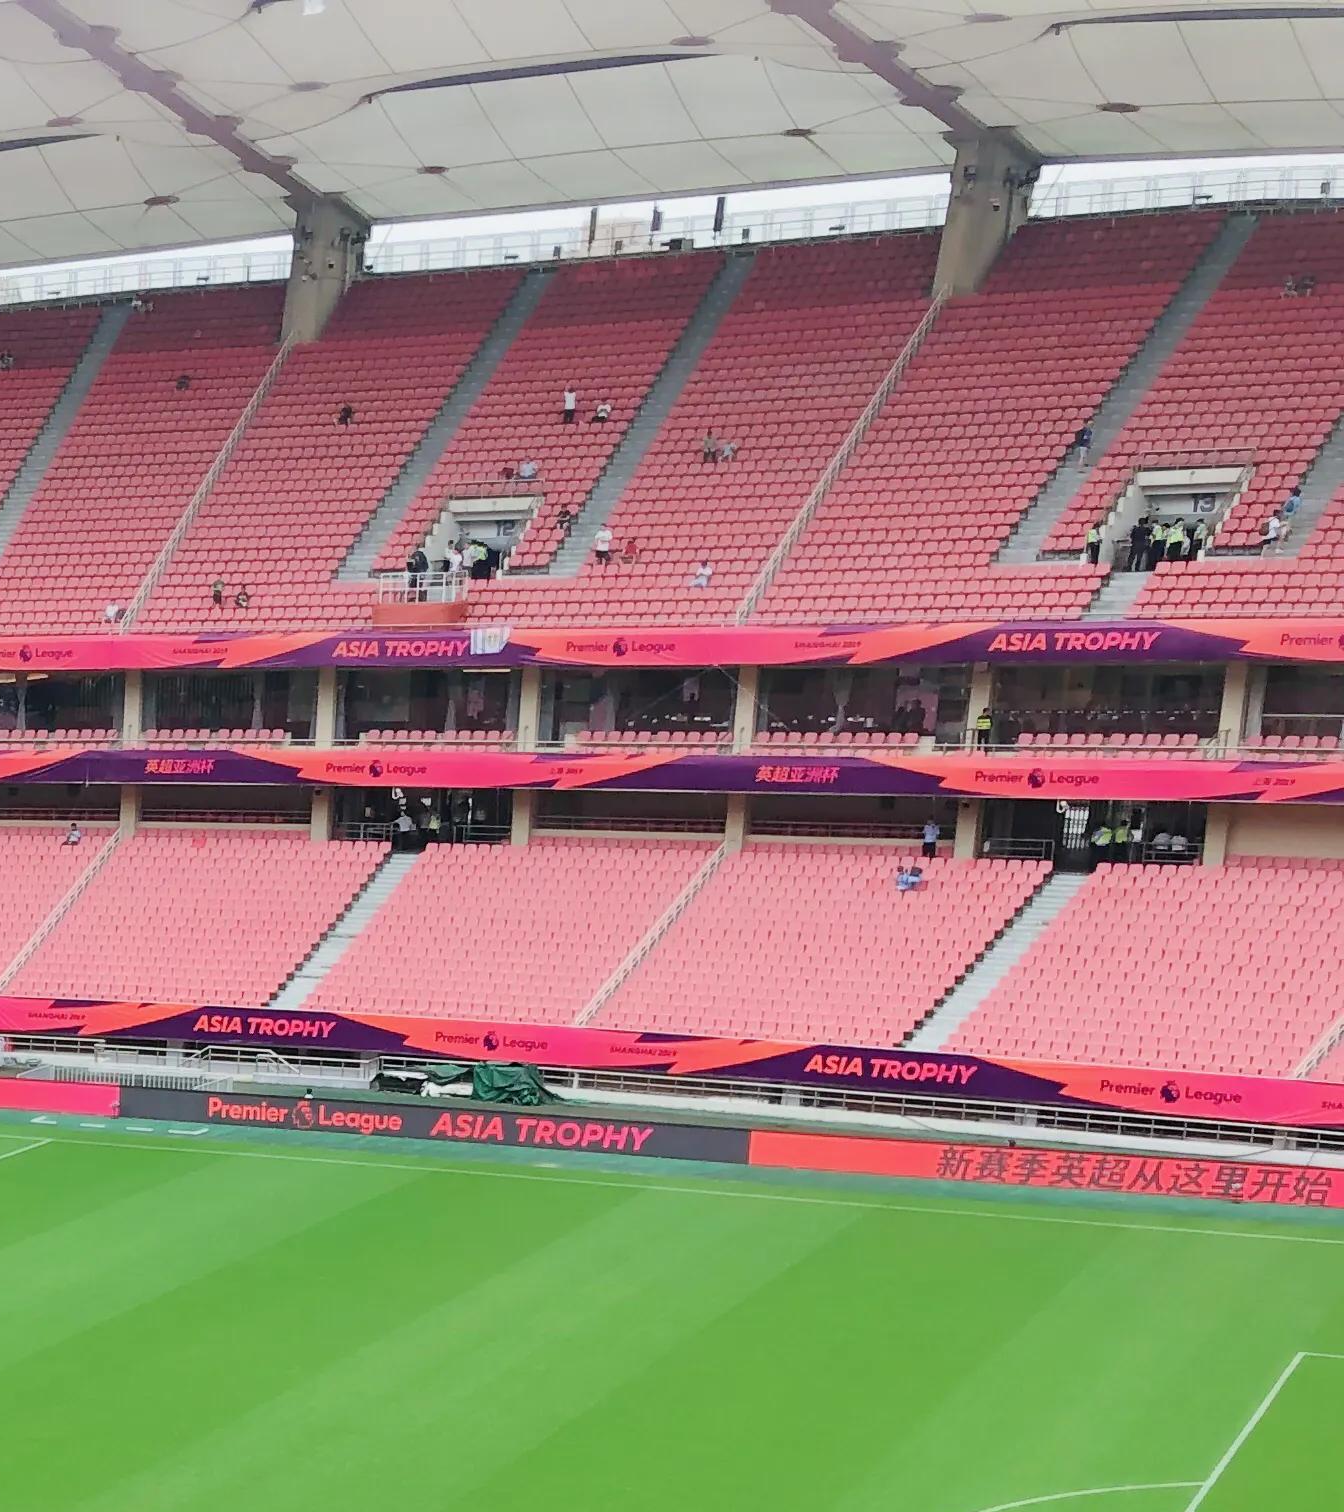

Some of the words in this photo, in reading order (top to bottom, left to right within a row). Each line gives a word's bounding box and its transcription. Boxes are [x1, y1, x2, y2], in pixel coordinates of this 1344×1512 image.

[566, 641, 608, 653] Premier
[631, 641, 676, 653] League
[988, 632, 1047, 652] ASIA
[1054, 631, 1161, 651] TROPHY
[1280, 633, 1333, 645] Premier
[35, 648, 74, 660] League
[332, 641, 379, 658] ASIA
[384, 641, 470, 659] TROPHY
[326, 762, 365, 774] Premier
[386, 763, 427, 776] League
[975, 772, 1024, 784] Premier
[1049, 772, 1100, 786] League
[193, 1015, 242, 1033] ASIA
[247, 1017, 337, 1039] TROPHY
[435, 1031, 480, 1046] Premier
[502, 1035, 548, 1051] League
[804, 1054, 863, 1076] ASIA
[870, 1058, 978, 1085] TROPHY
[1100, 1079, 1156, 1097] Premier
[1185, 1087, 1242, 1104] League
[208, 1097, 288, 1123] Premier
[318, 1104, 402, 1135] League
[430, 1112, 505, 1142] ASIA
[514, 1117, 655, 1152] TROPHY
[936, 1146, 1333, 1207] 新赛季英超从这里开始
